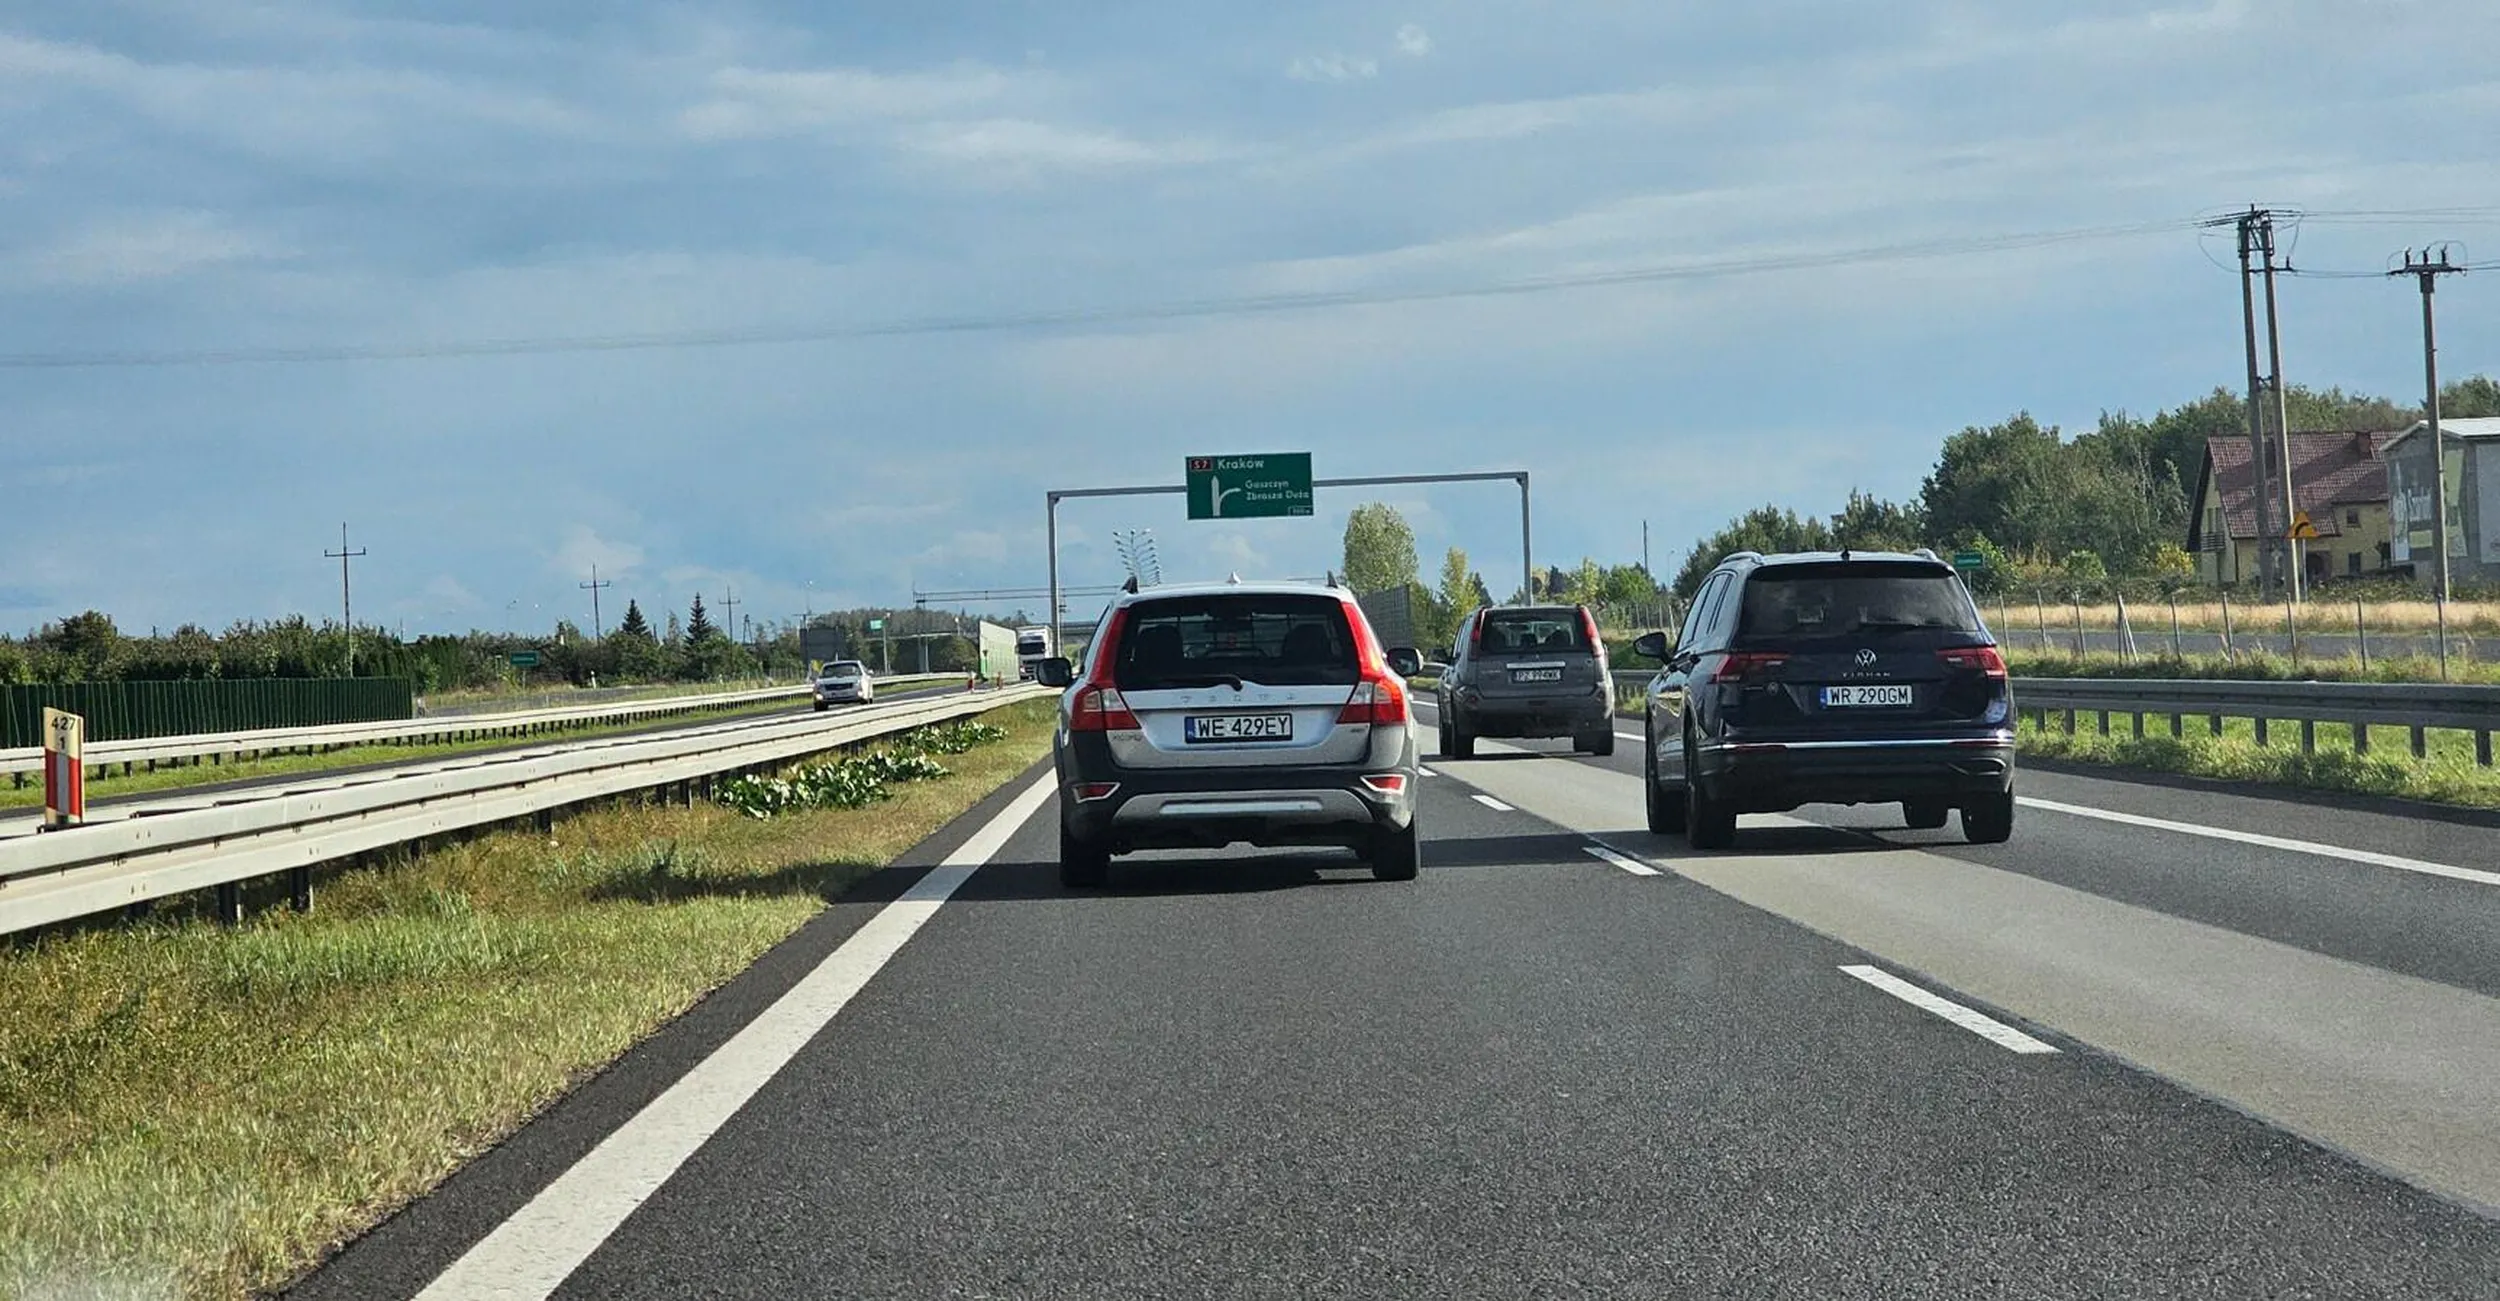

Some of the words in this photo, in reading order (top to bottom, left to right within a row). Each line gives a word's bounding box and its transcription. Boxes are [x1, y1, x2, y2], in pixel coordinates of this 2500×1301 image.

[1217, 457, 1264, 470] Kraków
[1830, 687, 1851, 704] WR
[1857, 687, 1909, 704] 290GM
[51, 716, 77, 731] 427
[1198, 718, 1225, 737] WE
[1230, 716, 1289, 737] 429EY
[59, 736, 66, 750] 1
